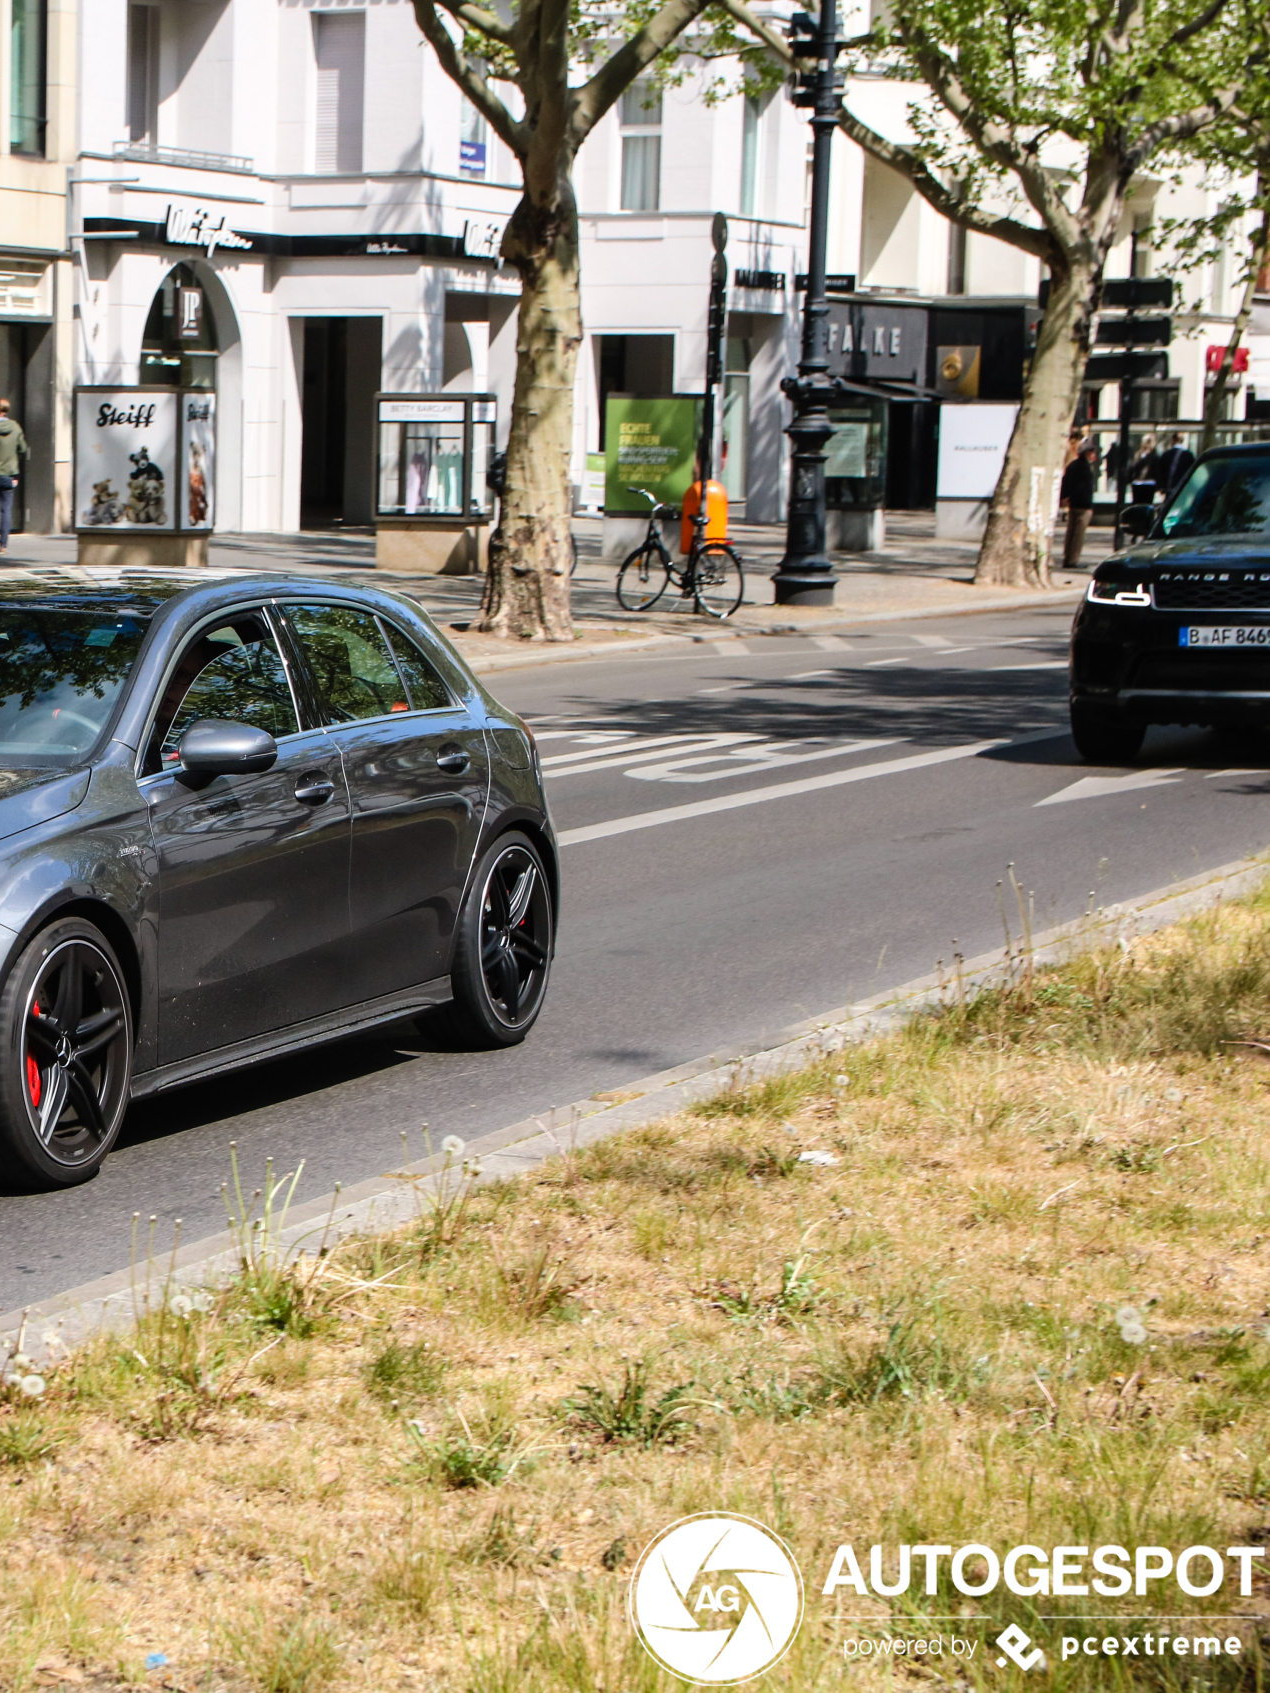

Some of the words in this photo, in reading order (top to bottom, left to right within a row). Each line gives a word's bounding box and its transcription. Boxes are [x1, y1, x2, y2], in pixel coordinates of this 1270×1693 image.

[183, 292, 200, 328] JP
[827, 323, 902, 355] FALKE
[96, 402, 156, 428] Steiff
[391, 405, 416, 413] BETTY
[1159, 573, 1230, 581] RANGE
[1189, 629, 1200, 644] B
[1211, 629, 1232, 644] AF
